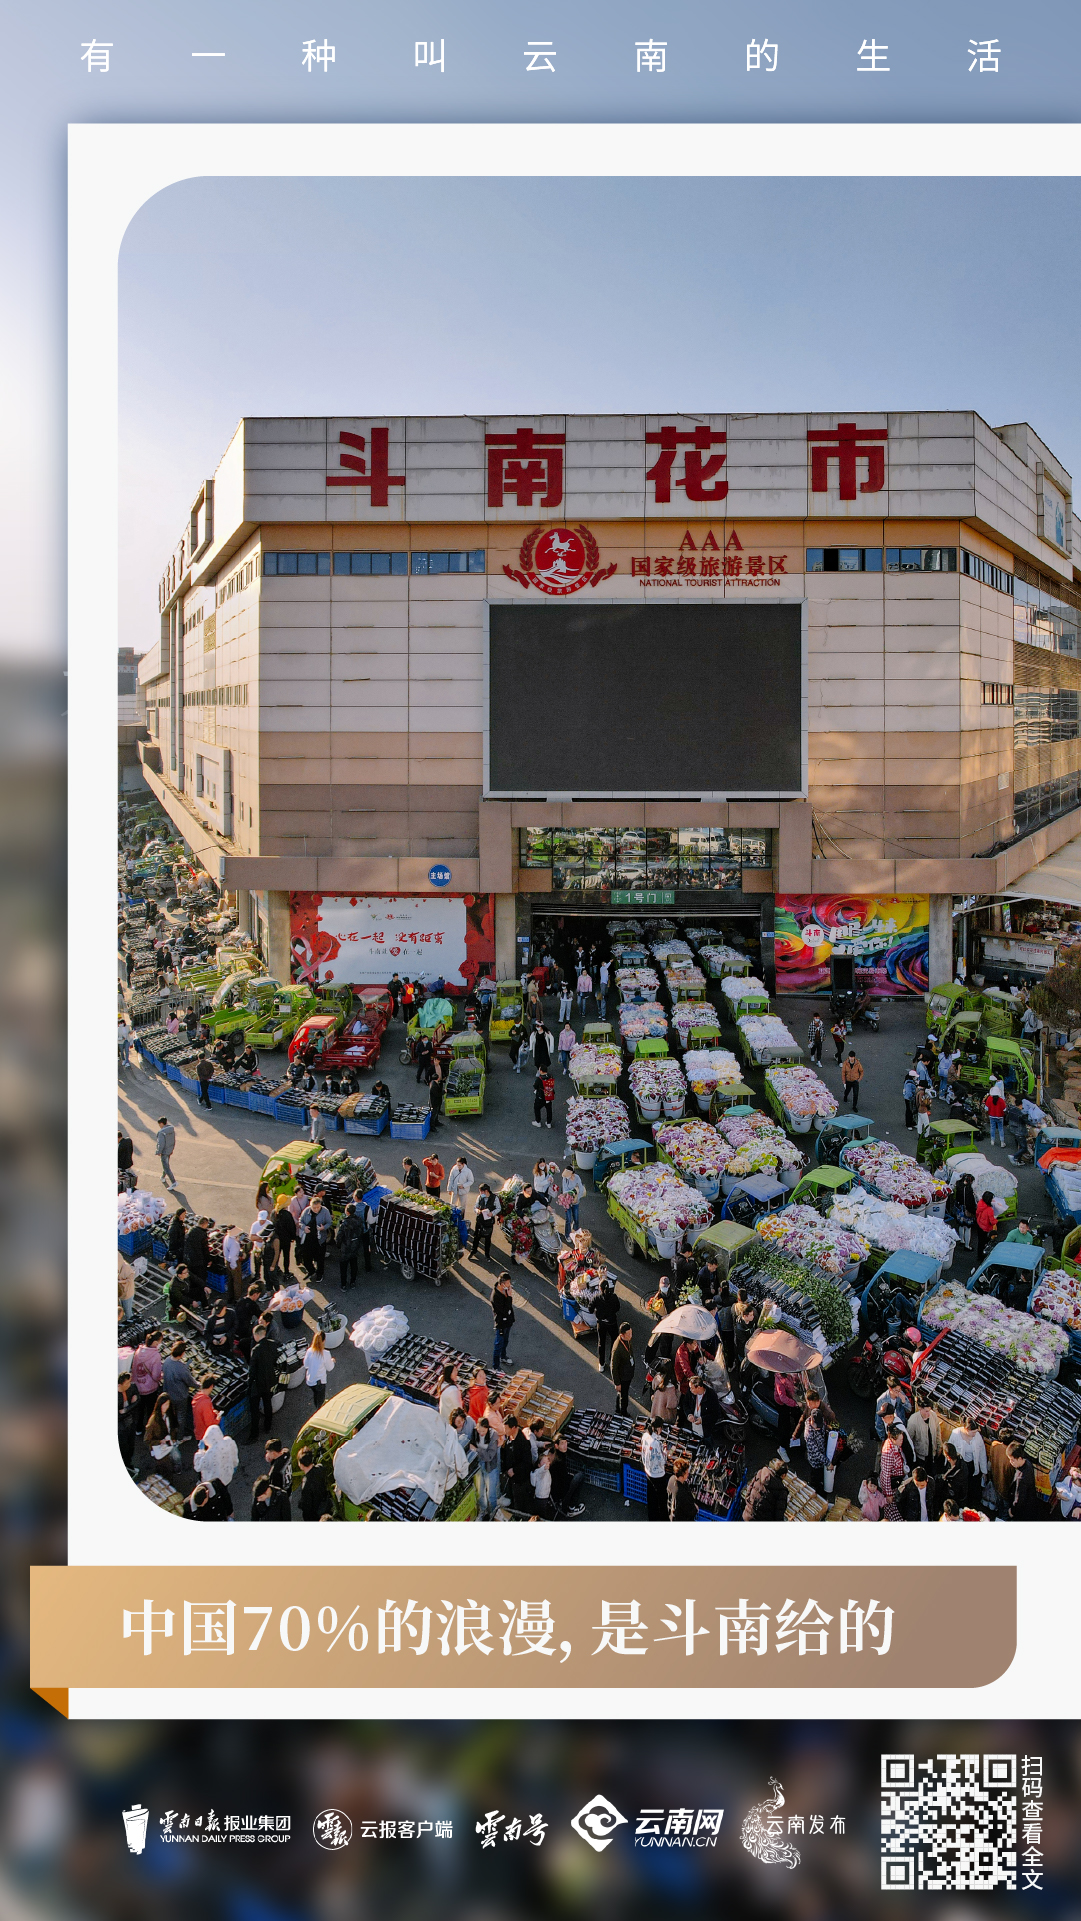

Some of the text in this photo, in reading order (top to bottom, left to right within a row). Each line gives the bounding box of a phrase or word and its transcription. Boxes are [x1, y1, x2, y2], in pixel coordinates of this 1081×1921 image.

[326, 423, 888, 507] 斗南花市
[679, 530, 745, 551] AAA
[630, 555, 789, 578] 国家级旅游景区
[639, 577, 781, 588] NATIONAL TOURIST ATTRACTION
[430, 871, 450, 880] 主场馆
[625, 892, 657, 903] 1号门
[336, 931, 445, 944] 心在一起 没有距离
[805, 928, 821, 937] 斗南
